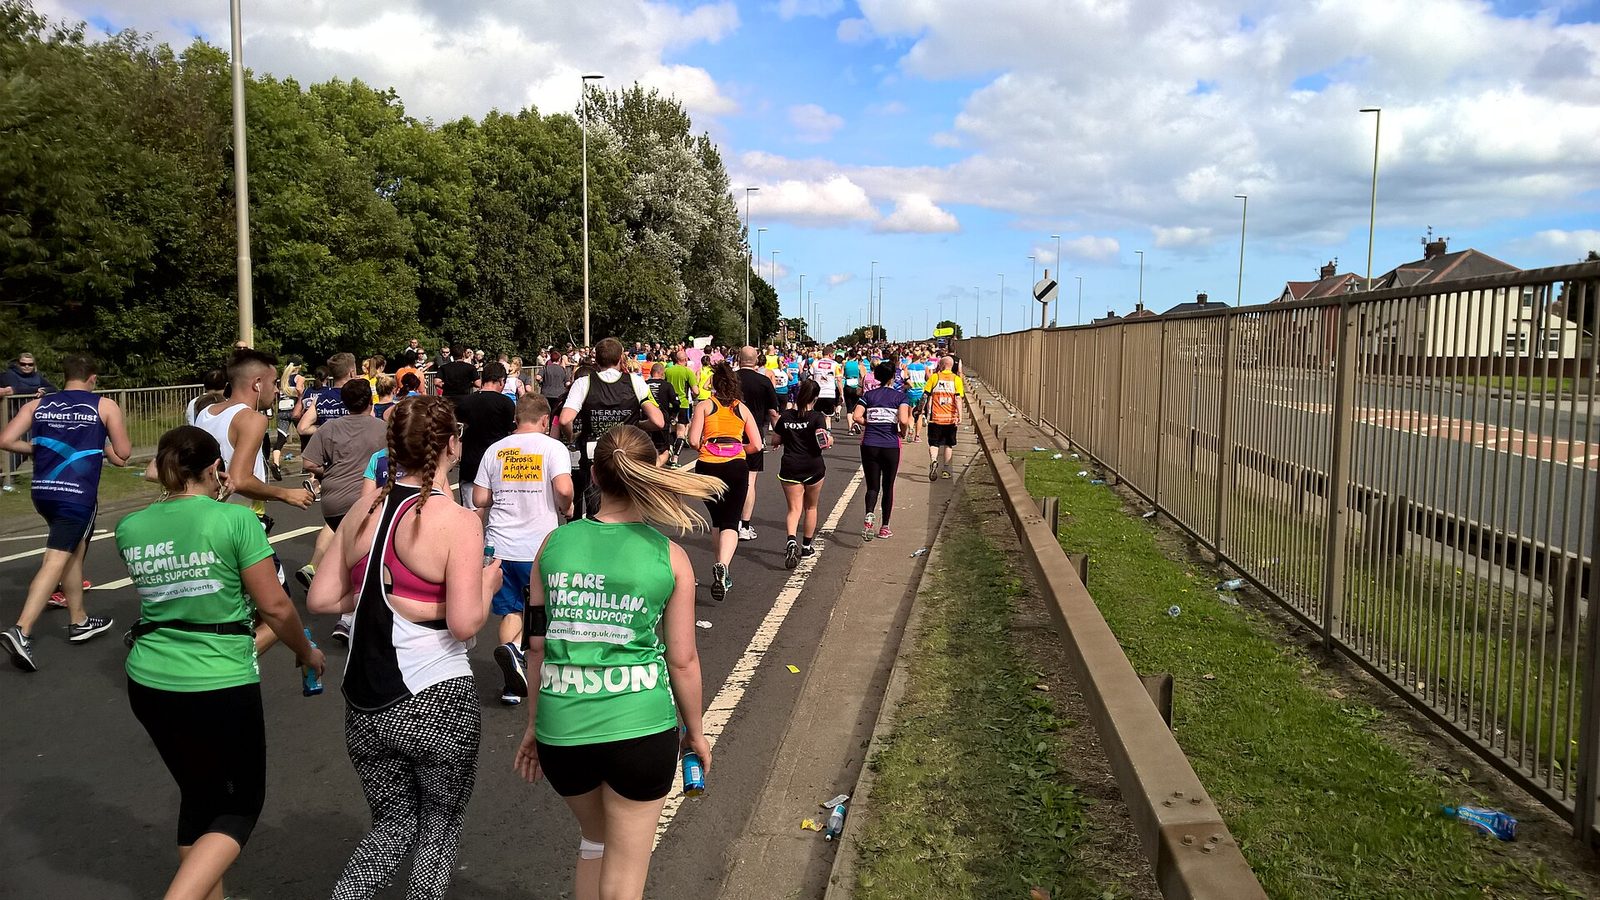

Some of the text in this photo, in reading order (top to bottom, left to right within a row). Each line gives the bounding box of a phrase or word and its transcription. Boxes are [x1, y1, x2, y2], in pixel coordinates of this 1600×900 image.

[34, 411, 71, 420] Calvert
[72, 412, 98, 422] Trust
[783, 421, 810, 430] FOXY
[497, 449, 520, 458] Cystic
[510, 463, 529, 475] fight
[524, 472, 539, 480] win
[123, 540, 174, 561] WE ARE
[164, 567, 210, 583] SUPPORT
[547, 572, 606, 590] WE ARE
[586, 608, 634, 624] SUPPORT
[539, 662, 659, 695] MASON
